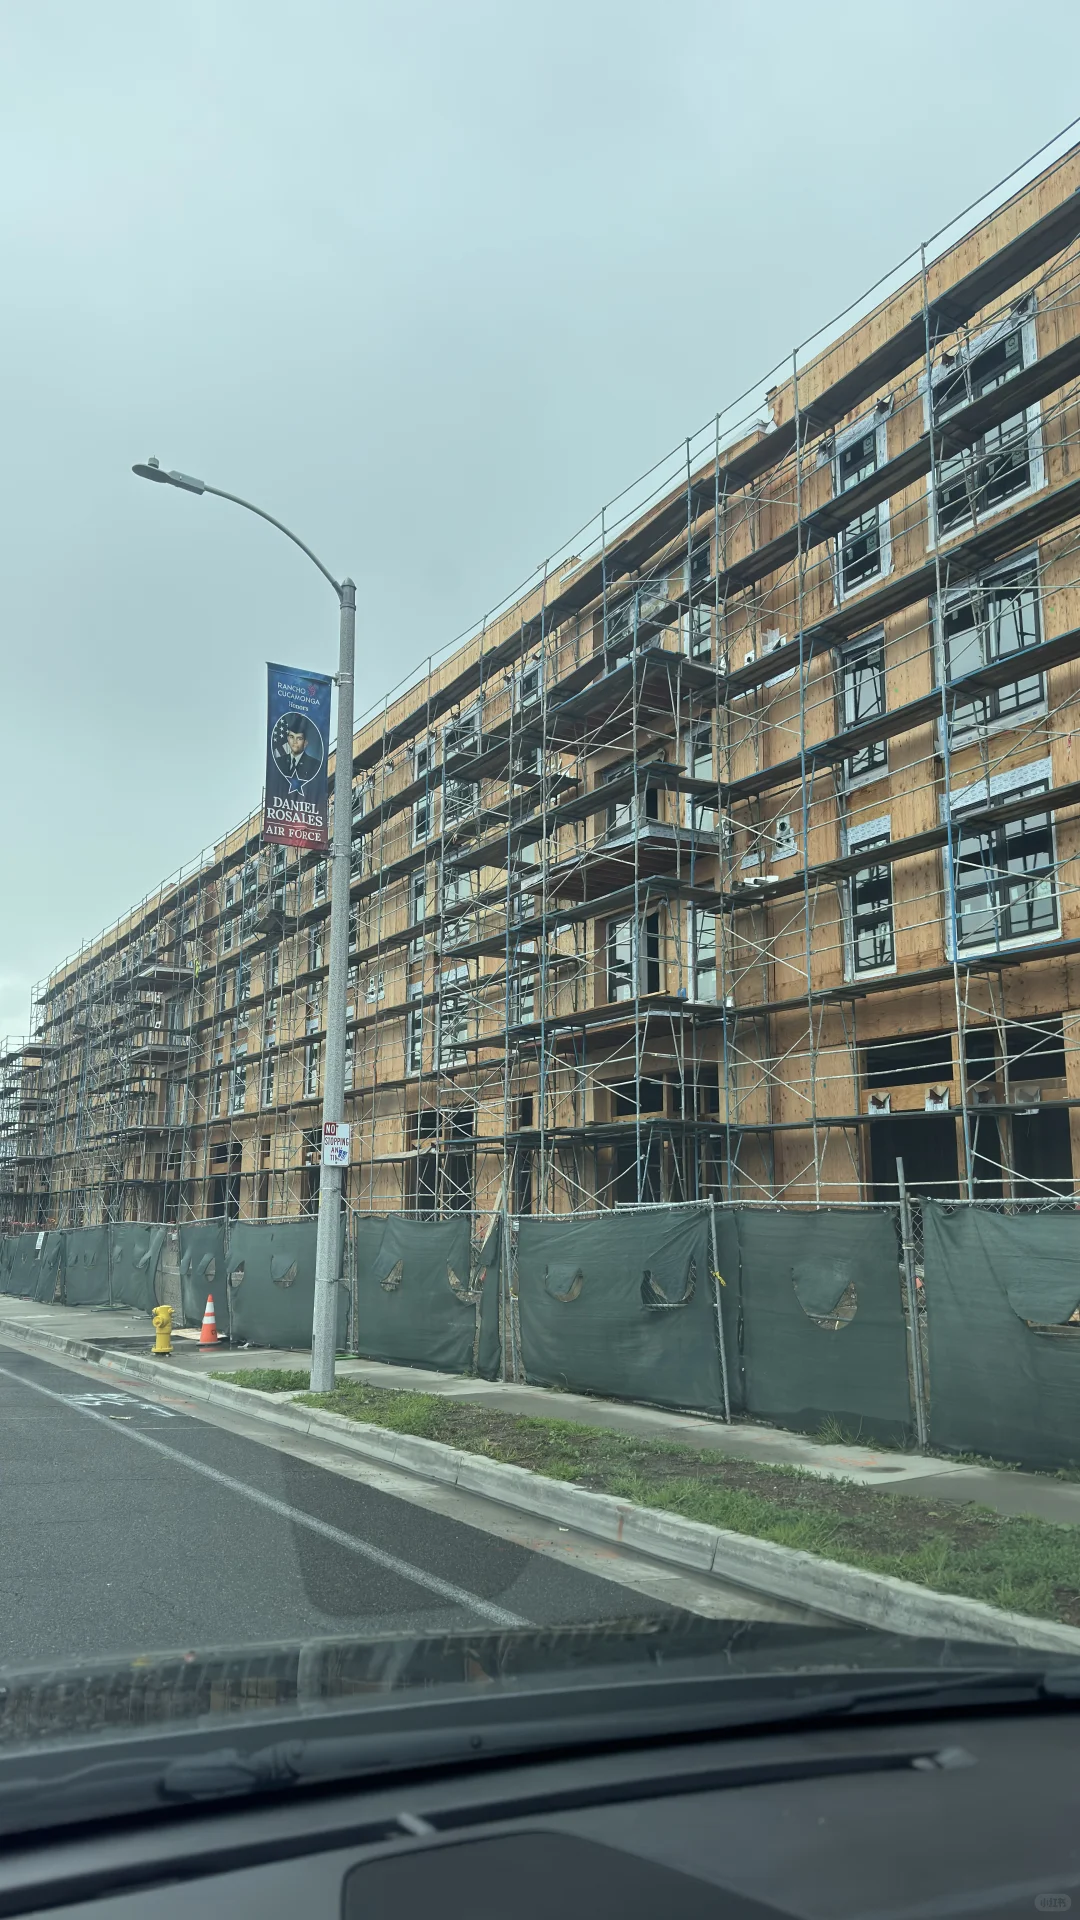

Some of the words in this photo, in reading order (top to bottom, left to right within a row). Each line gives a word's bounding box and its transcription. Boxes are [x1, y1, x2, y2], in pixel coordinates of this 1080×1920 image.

[277, 681, 306, 695] RANCHO
[277, 689, 320, 705] CUCAMONGA
[288, 700, 309, 711] Honors
[273, 796, 319, 815] DANIEL
[266, 807, 323, 827] ROSALES
[265, 824, 285, 836] AIR
[288, 828, 322, 842] FORCE
[325, 1123, 336, 1135] NO
[324, 1136, 349, 1146] STOPPING
